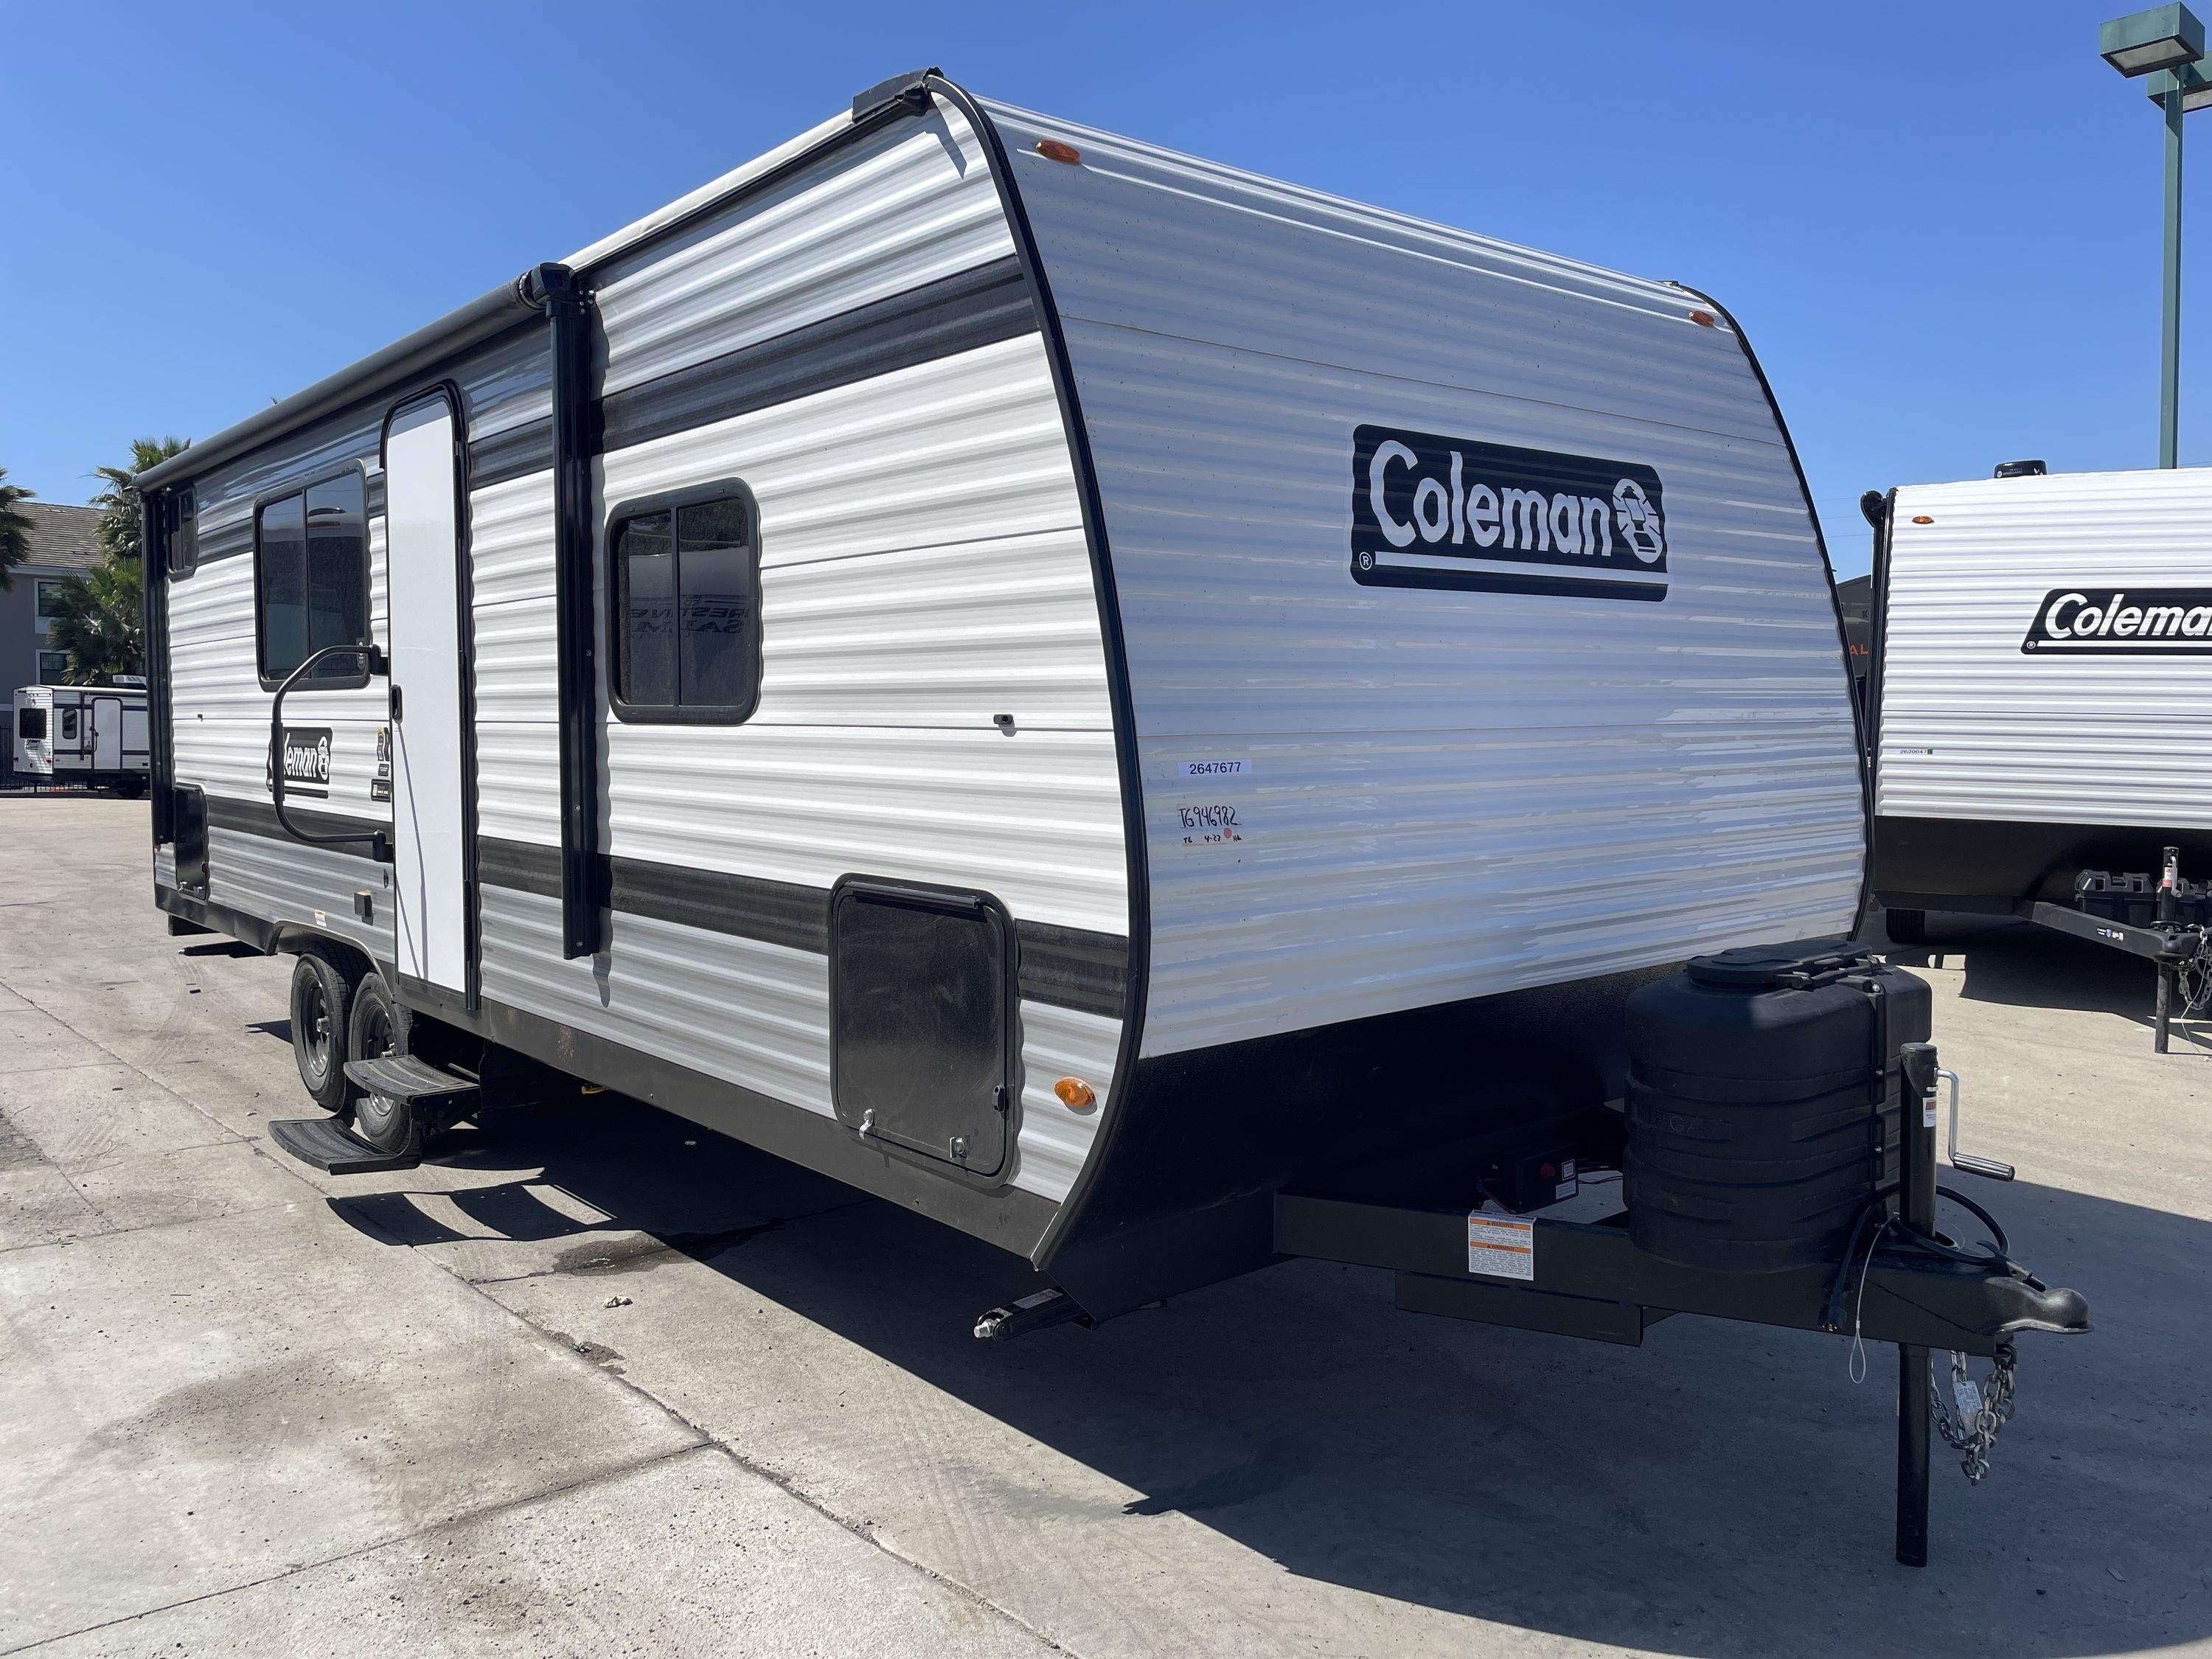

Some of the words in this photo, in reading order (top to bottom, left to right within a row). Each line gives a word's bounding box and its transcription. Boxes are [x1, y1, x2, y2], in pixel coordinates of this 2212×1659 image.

[1369, 439, 1613, 557] Coleman
[1849, 643, 1869, 655] AL
[283, 732, 319, 778] leman
[1189, 762, 1242, 775] 2647677
